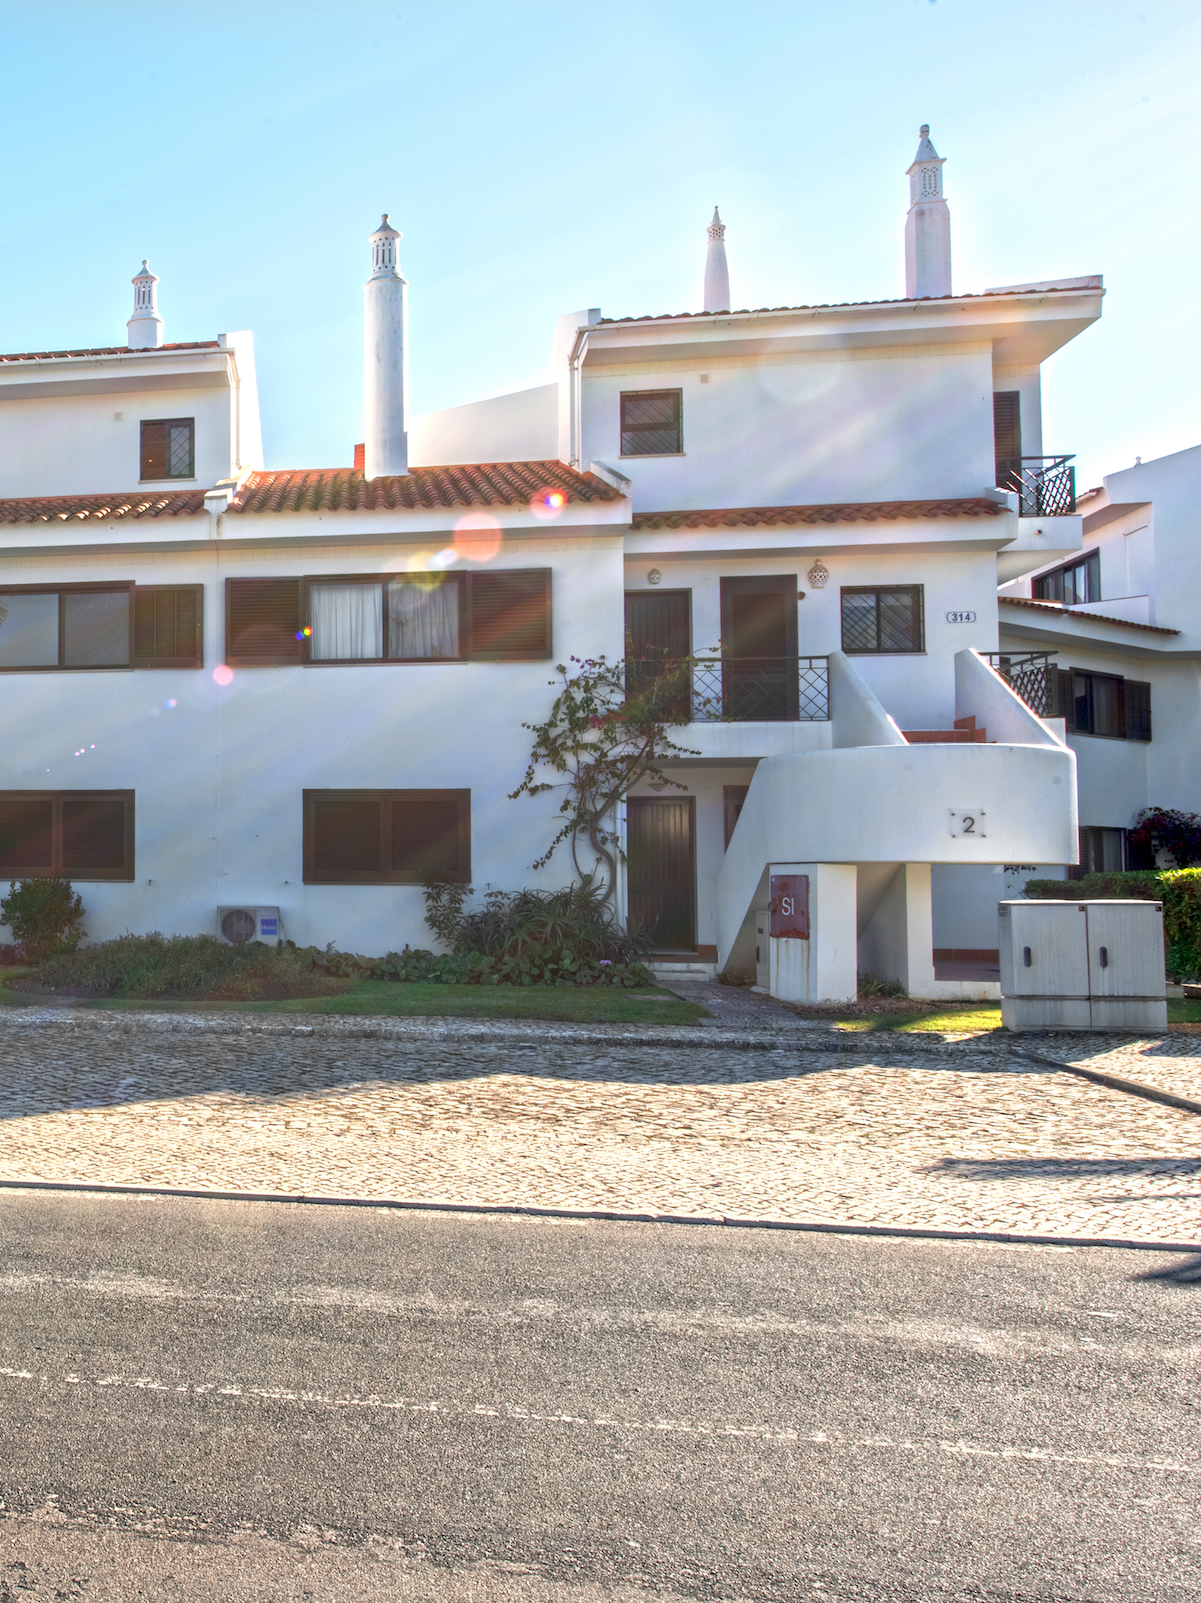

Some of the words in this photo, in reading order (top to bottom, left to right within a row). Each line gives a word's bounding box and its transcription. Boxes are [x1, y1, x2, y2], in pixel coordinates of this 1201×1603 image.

[952, 613, 971, 622] 314
[962, 817, 975, 833] 2
[781, 897, 794, 915] SI
